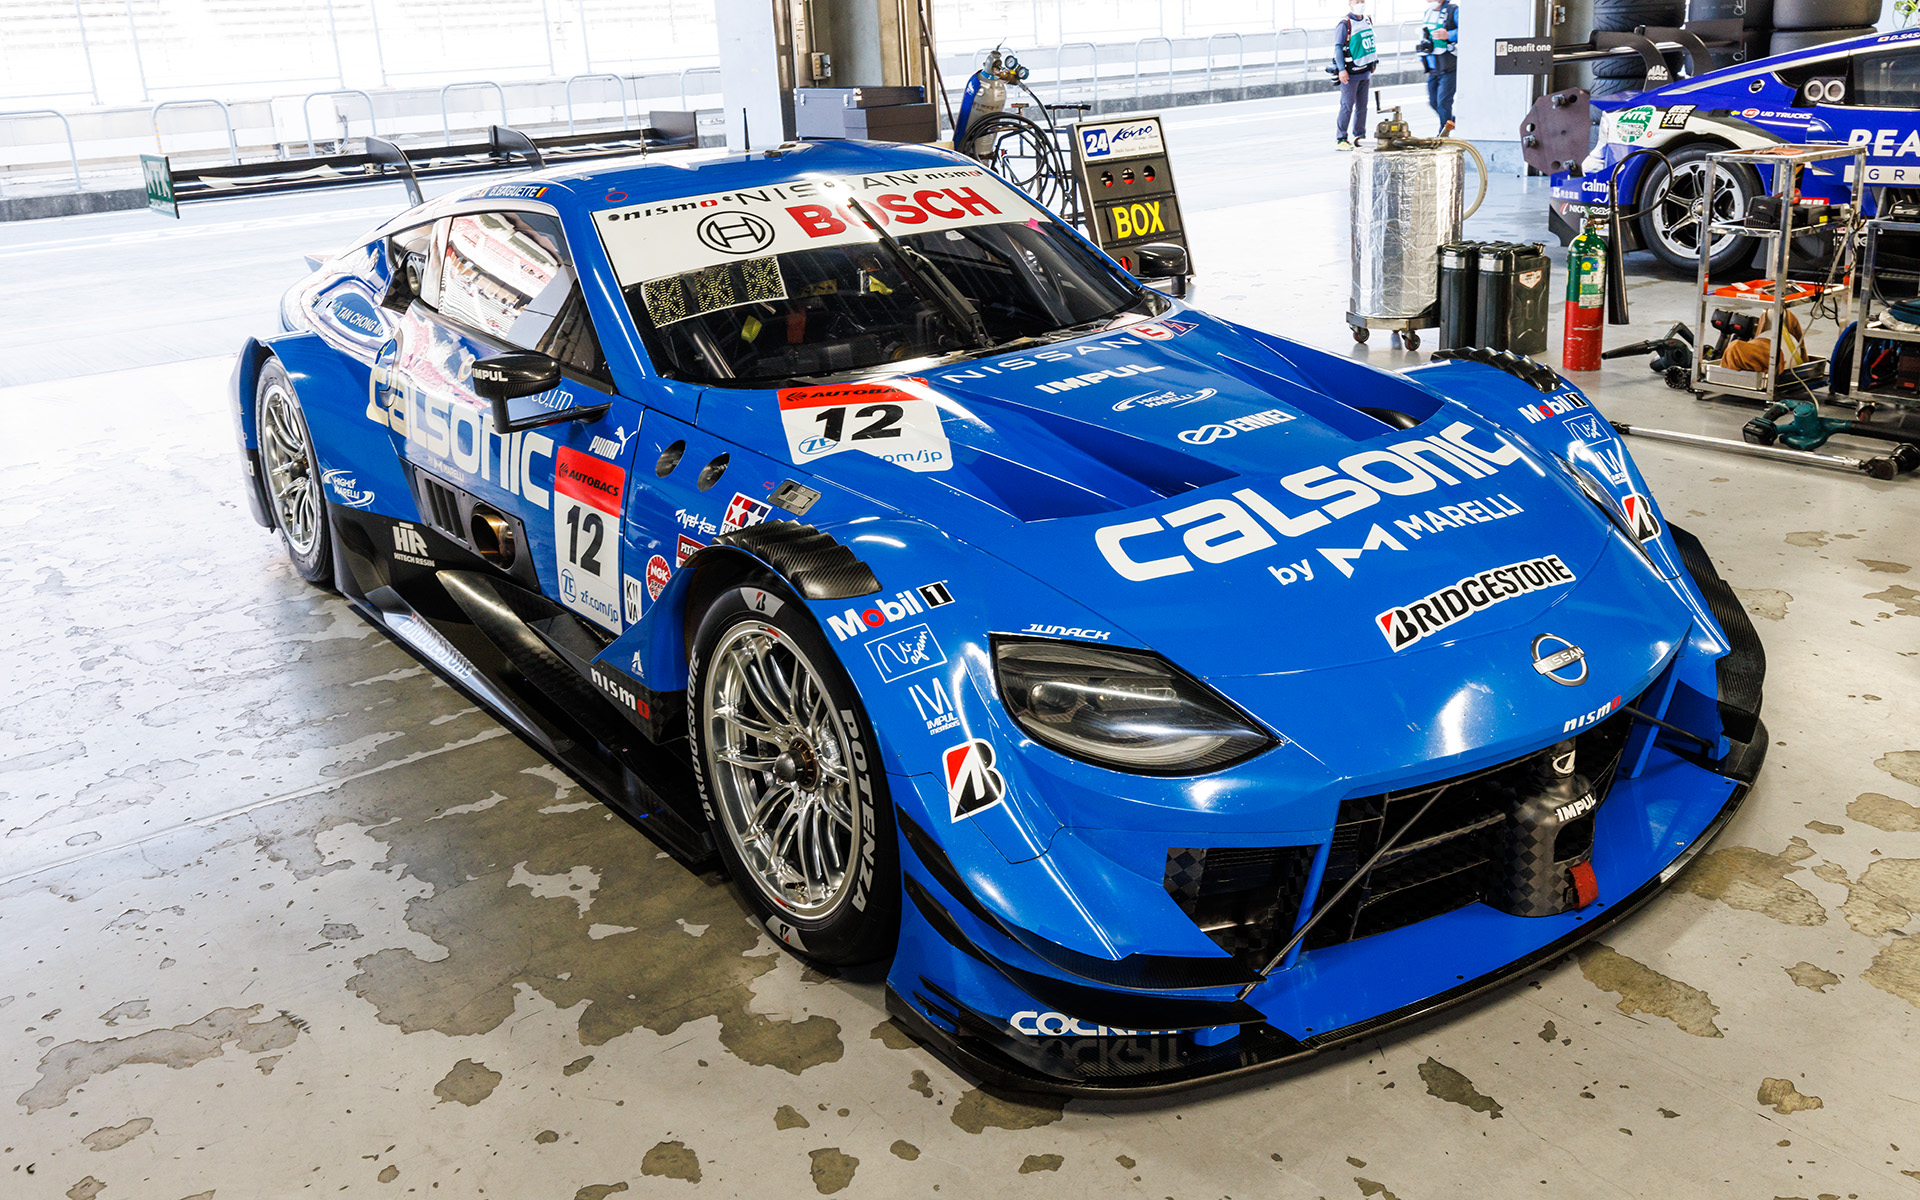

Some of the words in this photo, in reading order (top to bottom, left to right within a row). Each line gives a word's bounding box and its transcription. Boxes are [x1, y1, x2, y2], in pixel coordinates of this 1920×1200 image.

[1508, 43, 1535, 53] Benefit
[1536, 43, 1552, 52] one
[1776, 112, 1813, 120] TRUCKS
[1086, 132, 1108, 154] 24
[488, 186, 541, 198] B.BAGUETTE
[624, 199, 718, 221] nismo
[925, 170, 979, 182] nismo
[784, 186, 1003, 239] BOSCH
[1112, 201, 1166, 239] BOX
[337, 306, 350, 321] TAN
[349, 312, 376, 331] CHONG
[472, 367, 509, 383] IMPUL
[941, 336, 1142, 384] NISSAN
[1034, 363, 1166, 395] IMPUL
[1144, 393, 1194, 408] MARELLI
[1517, 395, 1575, 425] Mobil
[815, 403, 904, 442] 12
[1223, 408, 1297, 432] ENKEI
[588, 435, 621, 461] PUMA
[568, 469, 620, 497] AUTOBACS
[566, 504, 605, 577] 12
[1267, 558, 1315, 586] by
[1393, 493, 1525, 541] MARELLI
[650, 565, 669, 583] NGK
[580, 590, 619, 623] zf.com/jp
[826, 590, 923, 642] Mobil
[1380, 557, 1573, 648] BRIDGESTONE
[1021, 623, 1111, 641] JUNACK
[1536, 646, 1585, 674] NISSAN
[590, 667, 650, 720] nismo
[926, 712, 958, 730] IMPUL
[930, 720, 961, 735] members
[1562, 695, 1622, 734] nismo
[839, 708, 877, 913] POTENZA
[1555, 793, 1597, 823] IMPUL
